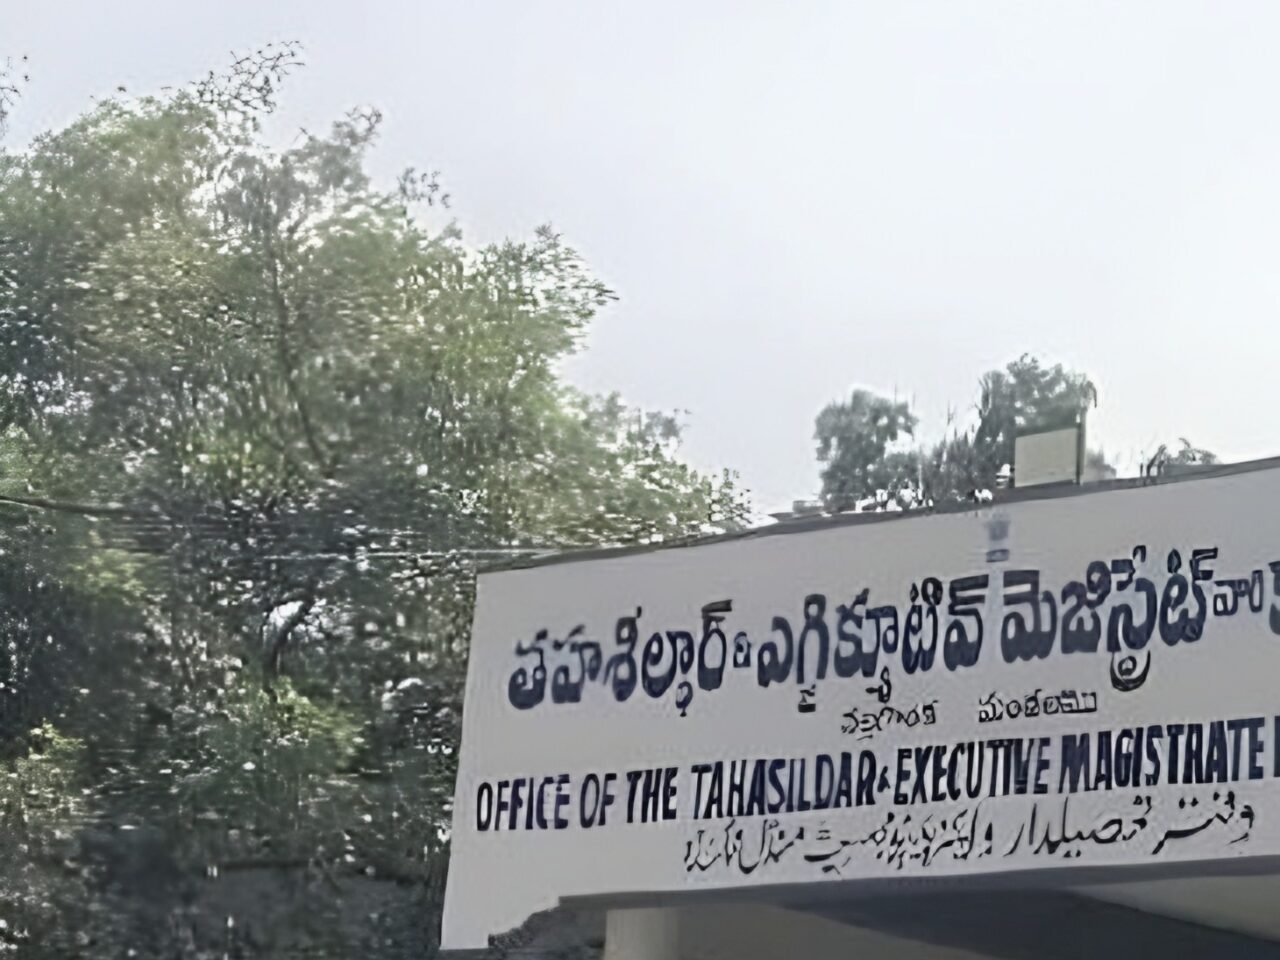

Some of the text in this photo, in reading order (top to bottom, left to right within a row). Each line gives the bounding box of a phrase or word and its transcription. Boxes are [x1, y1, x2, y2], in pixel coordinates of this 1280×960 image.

[476, 773, 571, 832] OFFICE
[579, 772, 618, 829] OF
[626, 766, 680, 824] THE
[691, 748, 877, 820] TAHASILDAR
[893, 737, 1051, 806] EXECUTIVE
[1058, 716, 1266, 795] MAGISTRATE
